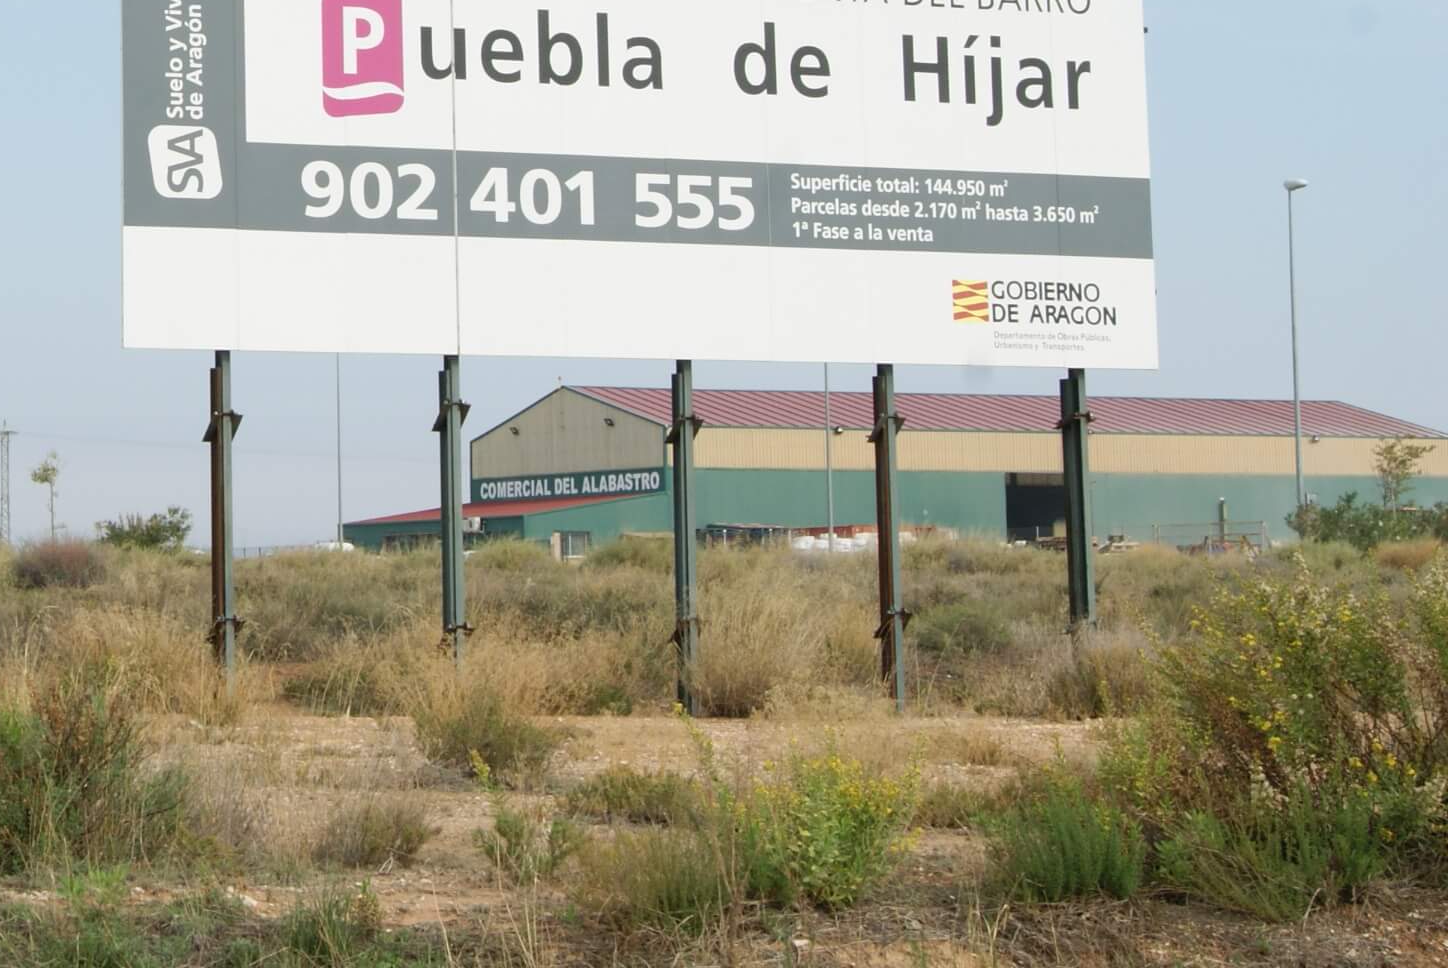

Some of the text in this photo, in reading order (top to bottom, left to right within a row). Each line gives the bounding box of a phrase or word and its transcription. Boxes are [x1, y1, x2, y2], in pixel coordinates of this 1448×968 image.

[169, 38, 187, 51] y
[184, 4, 207, 120] de Aragón
[341, 5, 1092, 127] Puebla de Híjar
[165, 57, 184, 119] Suelo
[300, 160, 755, 232] 902 401 555
[790, 172, 872, 194] Superficie
[876, 177, 920, 194] total:
[925, 179, 985, 197] 144.950
[791, 197, 858, 216] Parcelas
[862, 200, 910, 218] desde
[914, 202, 957, 219] 2.170
[986, 204, 1029, 222] hasta
[1033, 206, 1076, 223] 3.650
[814, 222, 849, 239] Fase
[853, 227, 864, 240] a
[868, 223, 883, 240] la
[888, 227, 934, 242] venta
[991, 280, 1100, 303] GOBIERNO
[992, 304, 1117, 326] DE ARAGON
[480, 471, 660, 500] COMERCIAL DEL ALABASTRO
